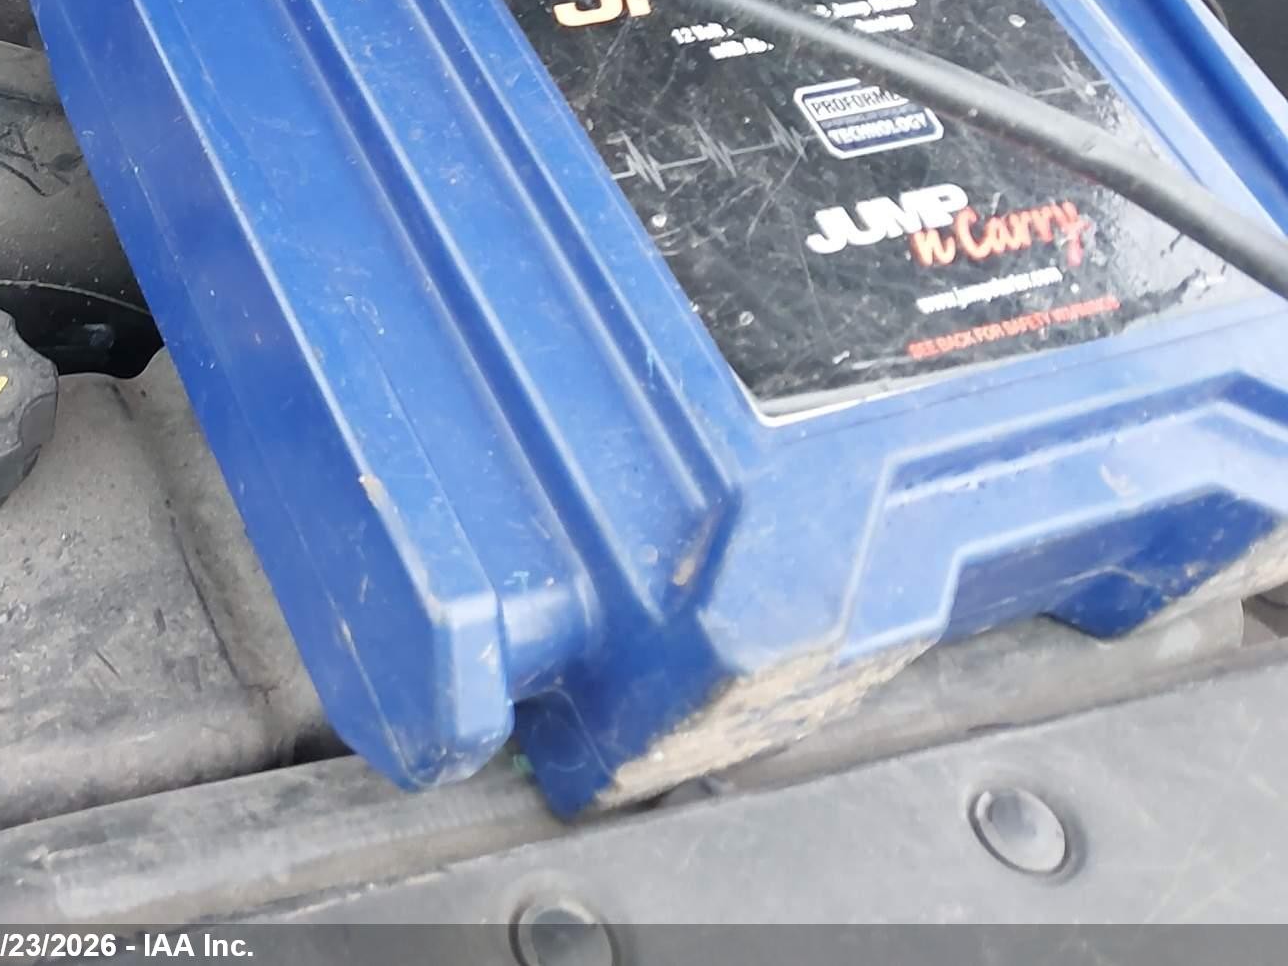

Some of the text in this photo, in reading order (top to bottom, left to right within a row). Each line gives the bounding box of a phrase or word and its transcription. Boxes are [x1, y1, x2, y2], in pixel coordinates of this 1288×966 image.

[827, 111, 928, 145] TECHNOLOGY
[806, 183, 969, 254] JUMP
[955, 200, 1091, 267] Carry
[935, 331, 976, 352] BACK
[972, 323, 1005, 343] FOR
